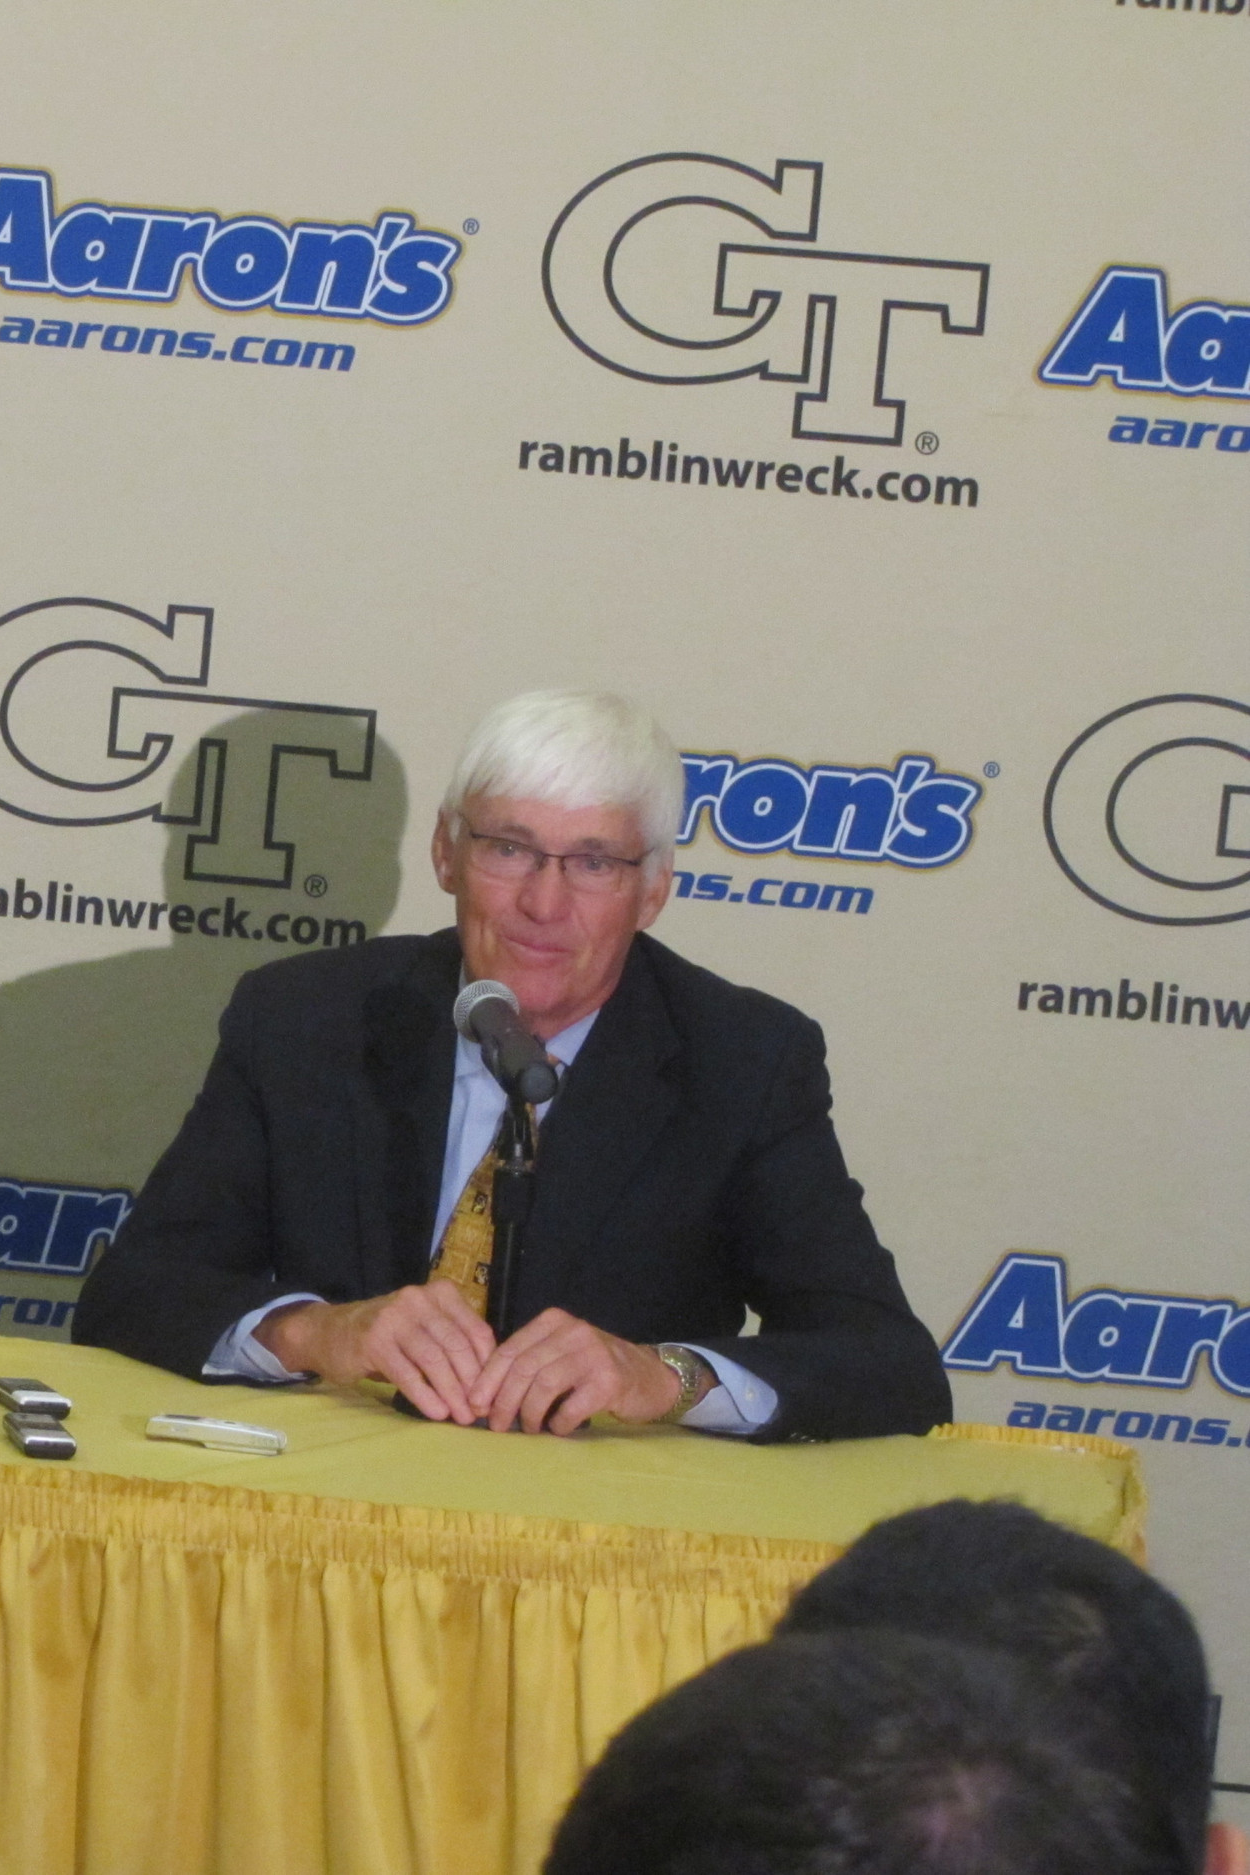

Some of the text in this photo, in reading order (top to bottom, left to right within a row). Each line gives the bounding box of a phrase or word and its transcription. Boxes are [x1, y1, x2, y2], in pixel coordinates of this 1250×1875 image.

[1037, 265, 1250, 399] Aa
[518, 437, 980, 508] ramblinwreck.com
[675, 753, 983, 869] ron's
[1043, 693, 1250, 926] G
[672, 870, 875, 914] ns.com
[1006, 1400, 1250, 1448] aarons.
